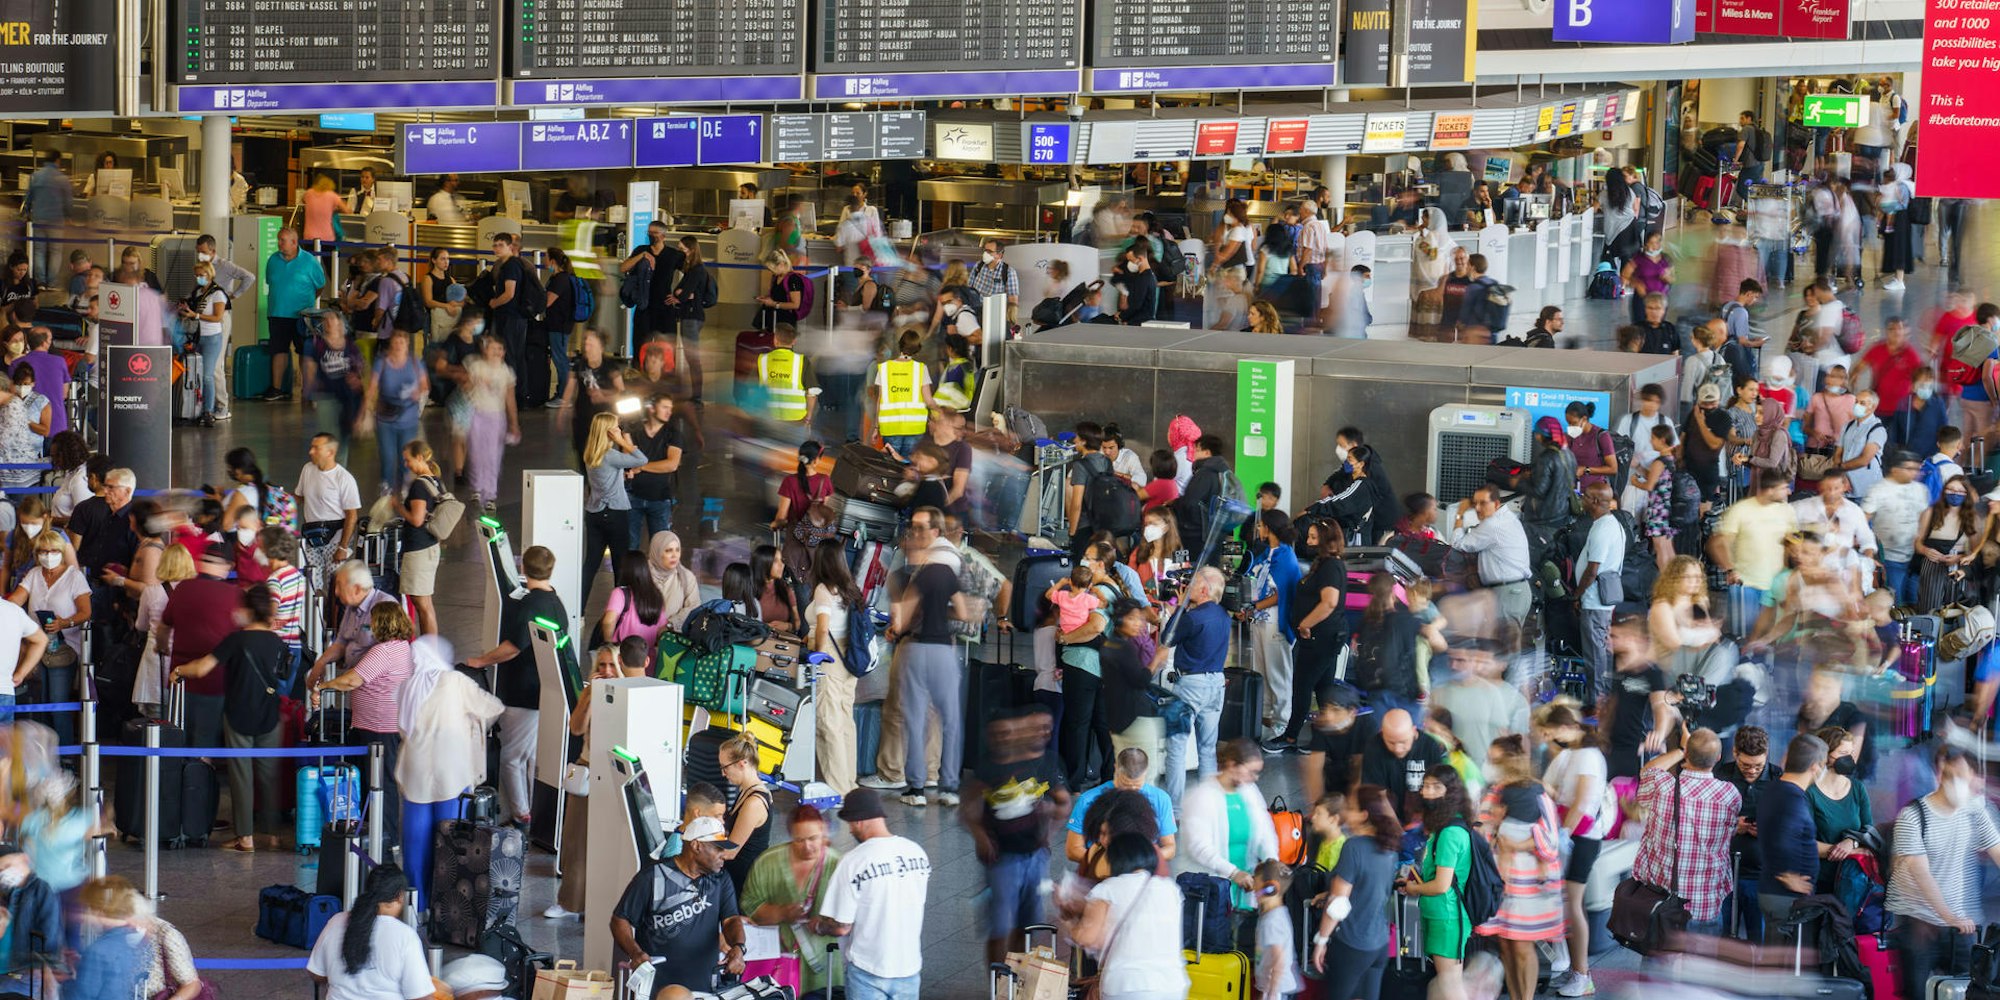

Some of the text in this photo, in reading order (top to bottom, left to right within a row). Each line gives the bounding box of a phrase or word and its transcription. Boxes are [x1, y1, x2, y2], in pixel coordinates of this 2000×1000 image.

[205, 2, 215, 10] LH
[226, 2, 244, 10] 3684
[255, 2, 337, 10] GOETTINGEN-KASSEL
[344, 1, 353, 10] BH
[539, 0, 547, 8] DE
[584, 0, 622, 8] ANCHORAGE
[1935, 0, 1958, 9] 300
[538, 11, 546, 21] DL
[561, 12, 574, 20] 087
[583, 11, 614, 20] DETROIT
[783, 10, 790, 18] E5
[1568, 0, 1593, 27] B
[1722, 8, 1774, 20] Miles & More
[1813, 8, 1840, 16] Frankfurt
[1028, 18, 1054, 26] 263-461
[1812, 15, 1833, 23] Airport
[1934, 18, 1990, 29] and 1000
[205, 24, 489, 34] LH 334 NEAPEL 263-461 A20
[538, 24, 547, 32] LH
[561, 23, 574, 31] 442
[583, 23, 614, 31] DETROIT
[1413, 20, 1425, 29] FOR
[1437, 20, 1462, 29] JOURNEY
[879, 31, 896, 39] PORT
[900, 30, 956, 38] HARCOURT-ABUJA
[1166, 26, 1200, 34] FRANCISCO
[34, 33, 51, 45] FOR
[52, 33, 69, 45] THE
[70, 33, 108, 45] JOURNEY
[205, 36, 489, 46] LH 438 DALLAS-FORT WORTH 263-461 Z19
[538, 32, 794, 43] LH 1152 PALMA DE MALLORCA 263-461 A34
[879, 41, 911, 49] BUKAREST
[1932, 37, 1997, 50] possibilities
[205, 50, 215, 58] LH
[230, 50, 244, 58] 582
[434, 48, 465, 56] 263-461
[475, 47, 488, 55] B27
[556, 46, 573, 54] 3714
[583, 45, 671, 53] HAMBURG-GOETTINGEN-H
[205, 59, 488, 70] LH 898 BORDEAUX 263-461 A17
[538, 54, 790, 66] LH 3534 AACHEN HBF-KOELN HBF T7
[1932, 56, 1956, 67] take
[1958, 59, 1980, 70] you
[26, 62, 65, 74] BOUTIQUE
[10, 76, 65, 85] FRANKFURT MÜNCHEN
[872, 78, 889, 86] Abflug
[19, 87, 33, 95] KÖLN
[576, 84, 593, 92] Abflug
[247, 90, 267, 98] Abflug
[247, 99, 279, 107] Departures
[1930, 95, 1964, 106] This is
[703, 120, 722, 139] D,E
[1370, 120, 1405, 131] TICKETS
[1438, 122, 1469, 131] TICKETS
[438, 127, 477, 144] Abflug C
[547, 123, 610, 142] Abflug A,B,Z
[438, 136, 466, 145] Departures
[1034, 136, 1060, 147] 500-
[1034, 149, 1053, 161] 570
[769, 371, 790, 379] Crew
[891, 385, 910, 393] Crew
[652, 899, 712, 930] Reebok
